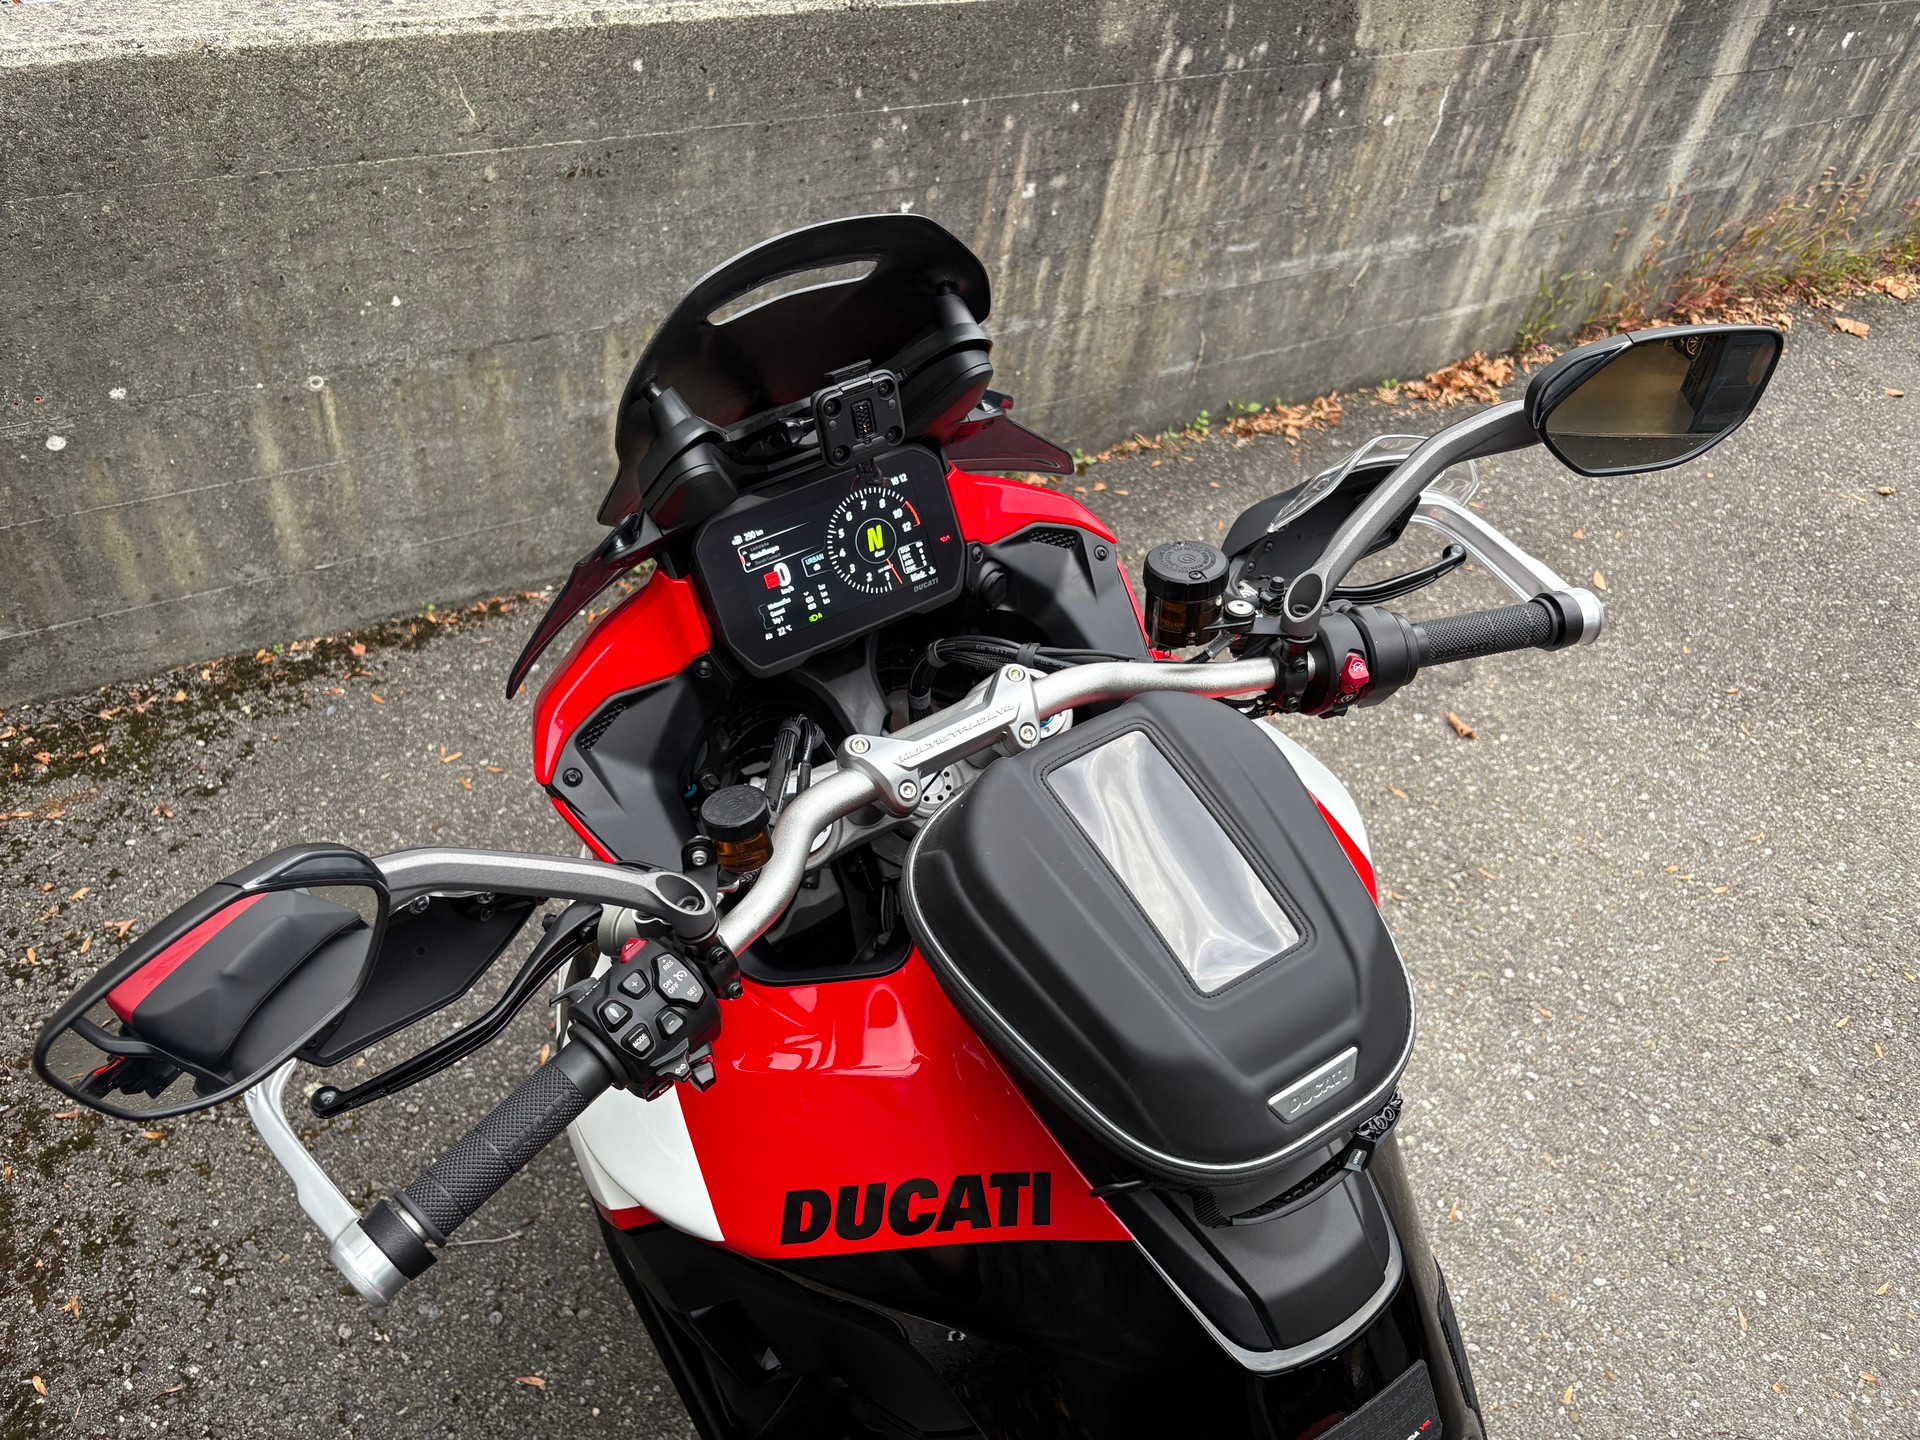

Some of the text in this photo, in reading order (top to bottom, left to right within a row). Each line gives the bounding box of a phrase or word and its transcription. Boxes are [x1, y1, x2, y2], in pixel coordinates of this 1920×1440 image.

[860, 500, 867, 510] 7
[879, 498, 886, 508] 8
[846, 511, 852, 522] 6
[892, 508, 903, 519] 10
[838, 528, 845, 538] 5
[902, 522, 912, 532] 12
[743, 530, 756, 542] 290
[867, 524, 884, 552] N
[839, 548, 846, 558] 4
[804, 553, 824, 566] URBAN
[774, 562, 792, 587] 0
[849, 564, 856, 574] 3
[866, 572, 872, 582] 2
[884, 571, 890, 581] 1
[914, 578, 939, 592] DUCATI
[776, 626, 786, 636] 22
[662, 960, 674, 972] RES
[662, 978, 674, 990] ON
[668, 982, 680, 994] OFF
[686, 985, 698, 997] SET
[632, 1032, 648, 1048] MODE
[1288, 1064, 1348, 1114] DUCATI
[780, 1171, 1052, 1246] DUCATI
